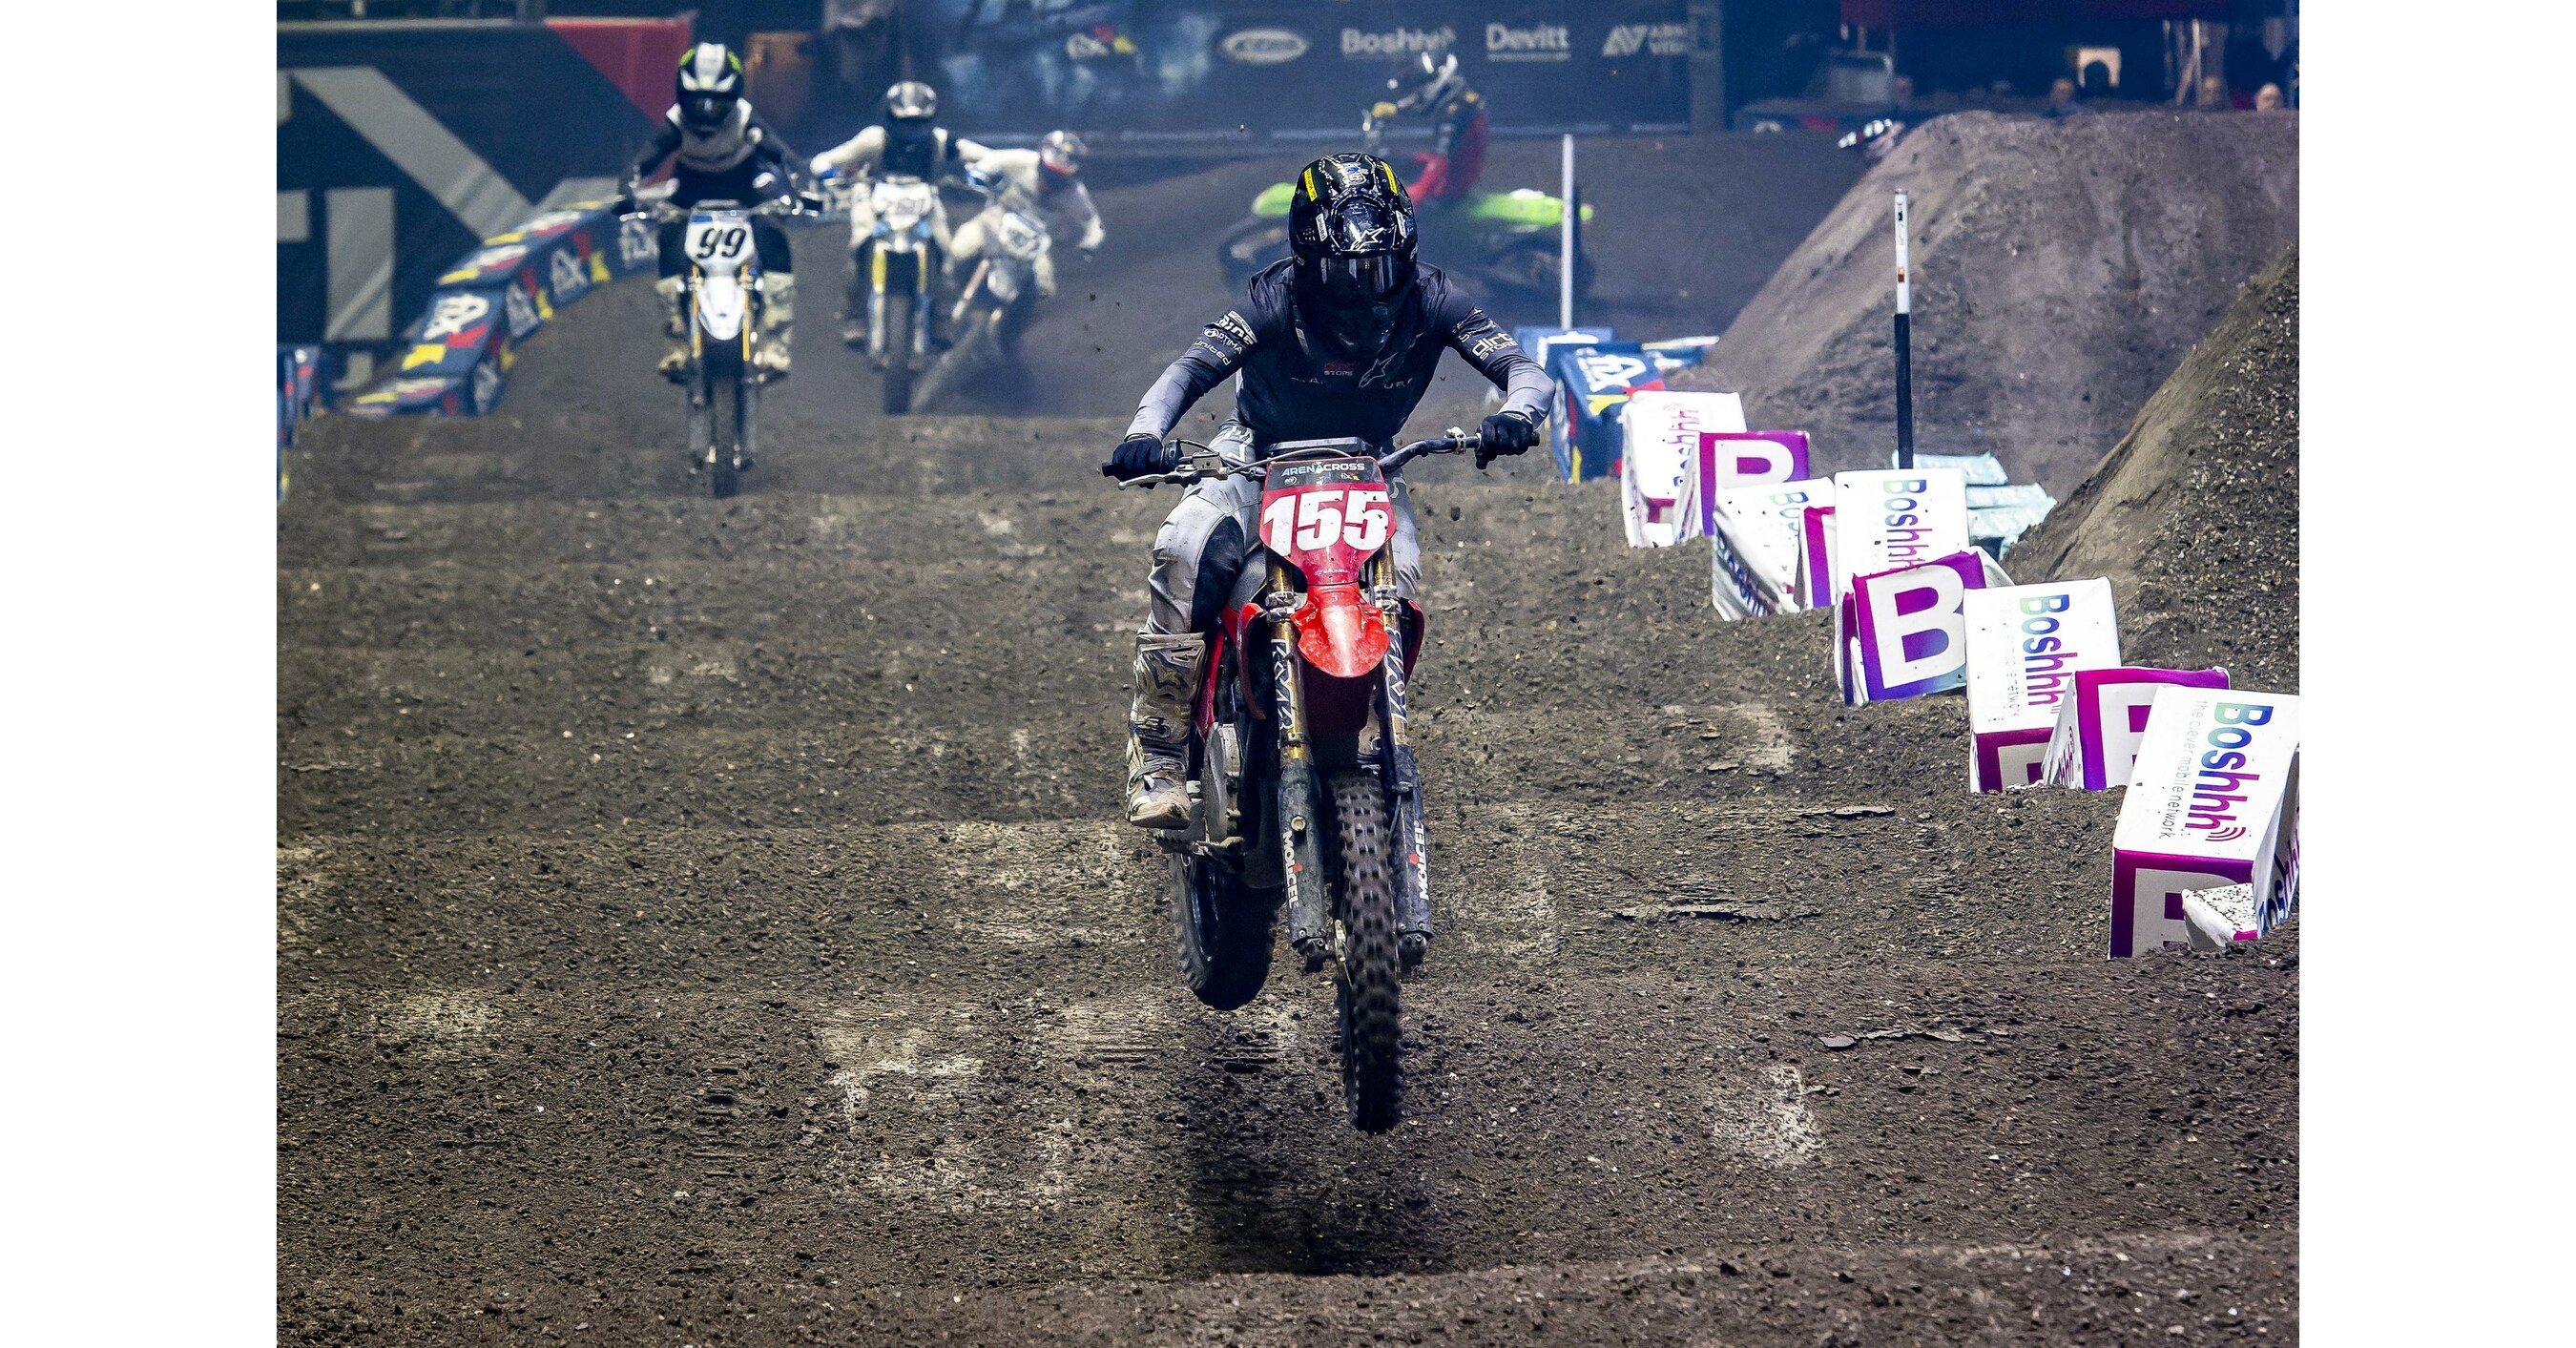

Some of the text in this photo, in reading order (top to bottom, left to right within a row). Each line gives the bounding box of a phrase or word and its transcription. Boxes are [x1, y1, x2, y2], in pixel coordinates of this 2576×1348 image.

[696, 228, 746, 259] 99
[1472, 333, 1513, 357] dirt
[1480, 341, 1518, 361] STORE
[1281, 463, 1365, 476] ARENACROSS
[1263, 489, 1390, 557] 155
[1866, 565, 1965, 689] B
[2020, 594, 2078, 706] Boshhh
[2158, 701, 2211, 840] the clever mobile network
[2185, 701, 2274, 830] Boshhh
